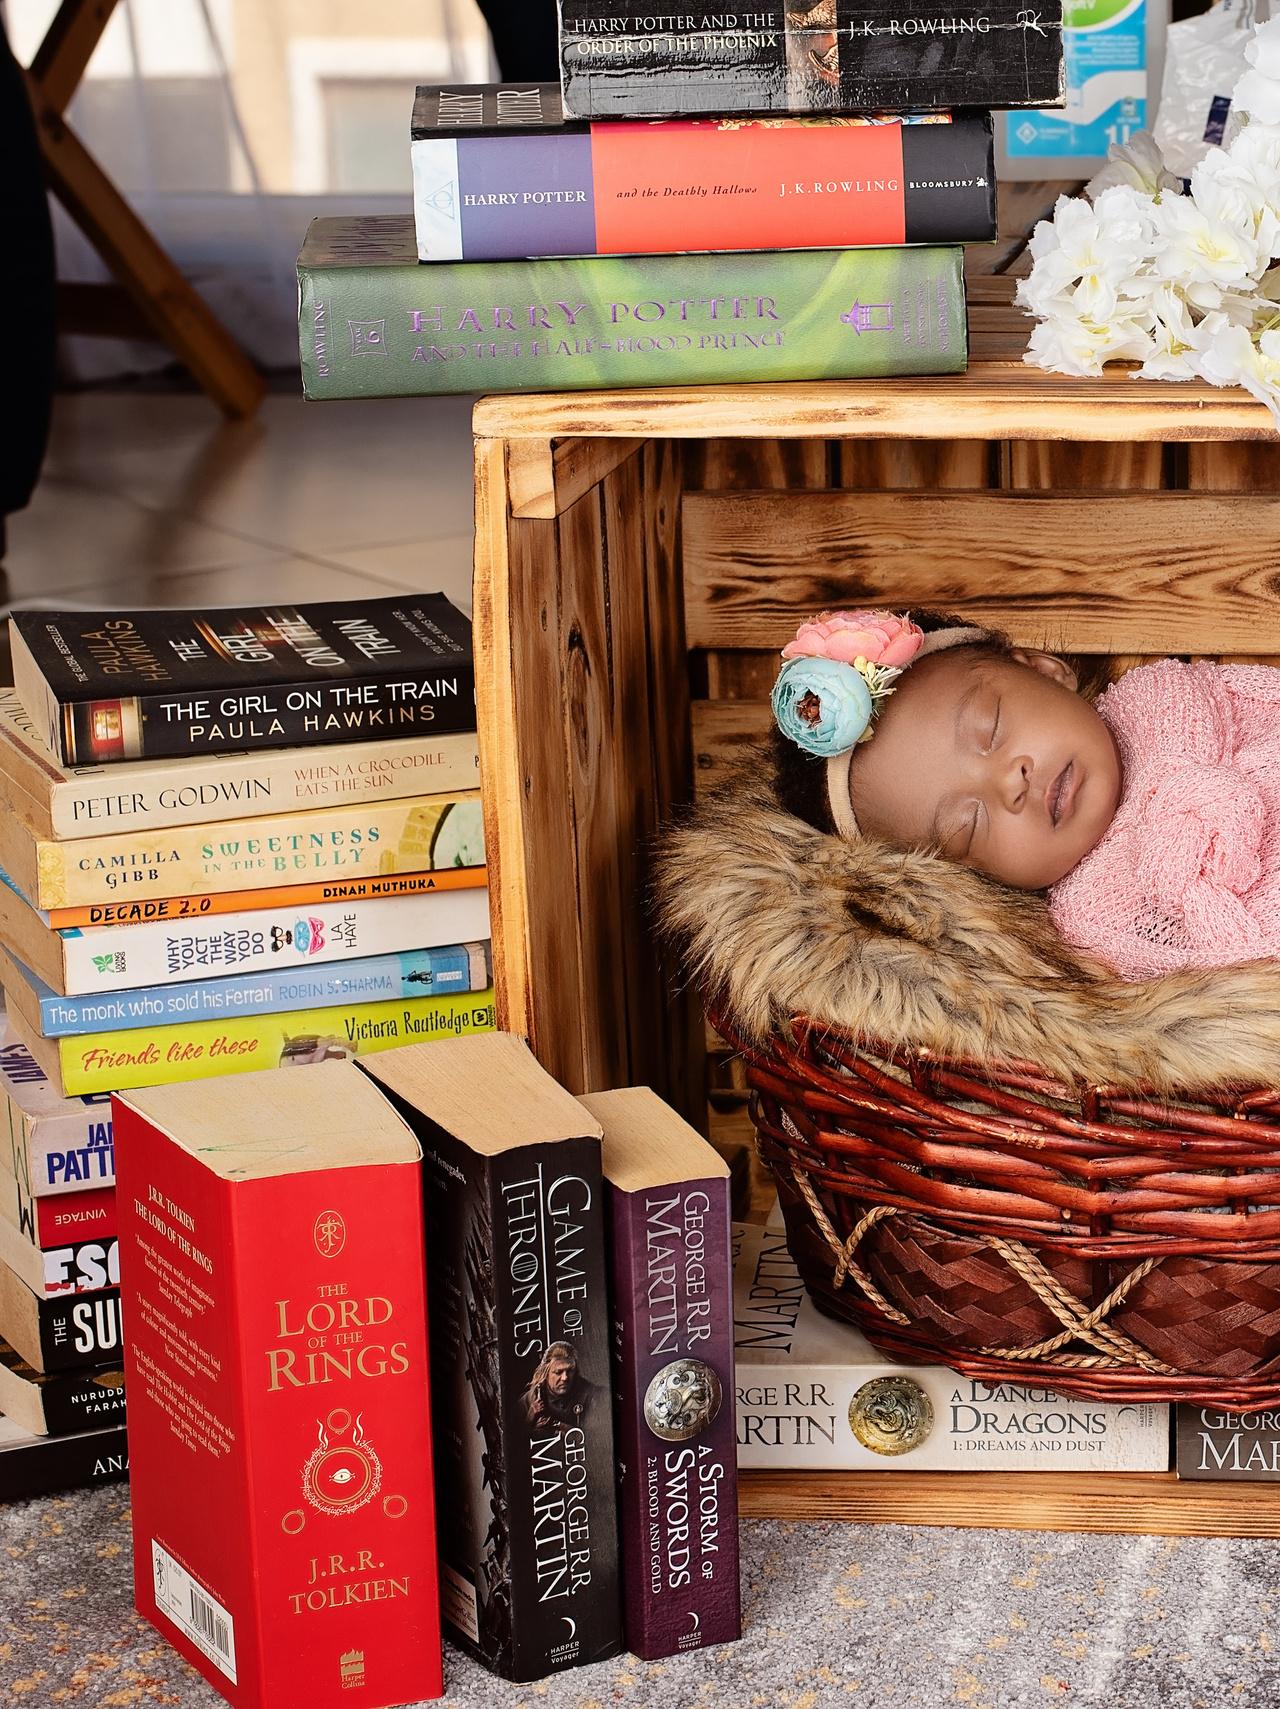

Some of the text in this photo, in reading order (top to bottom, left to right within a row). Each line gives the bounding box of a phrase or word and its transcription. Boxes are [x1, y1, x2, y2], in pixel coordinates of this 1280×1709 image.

[575, 12, 776, 33] HARRY POTTER AND THE
[849, 16, 991, 41] J.K. ROWLING
[577, 33, 778, 56] ORDER OF THE PHOENIX
[437, 91, 484, 126] HARRY
[464, 190, 588, 207] HARRY POTTER
[615, 183, 758, 199] and the Deathly Hallows
[908, 179, 974, 190] BLOOMSBURY
[406, 295, 780, 333] HARRY POTTER
[313, 299, 329, 378] ROWLING
[411, 330, 787, 363] AND THE HALF-BLOOD PRINCE
[81, 630, 133, 675] PAULA
[104, 619, 173, 682] HAWKINS
[168, 638, 208, 662] THE
[218, 627, 275, 663] GIRL
[332, 618, 402, 660] TRAIN
[294, 645, 347, 667] ON
[160, 677, 458, 722] THE GIRL ON THE TRAIN
[189, 704, 437, 743] PAULA HAWKINS
[294, 751, 446, 782] WHEN A CROCODILE
[72, 777, 272, 821] PETER GODWIN
[295, 773, 394, 798] EATS THE SUN
[201, 826, 381, 860] SWEETNESS
[78, 850, 182, 872] CAMILLA
[204, 847, 366, 874] IN THE BELLY
[105, 868, 160, 890] GIBB
[323, 878, 436, 899] DINAH MUTHUKA
[90, 900, 170, 924] DECADE
[179, 897, 212, 915] 2.0
[237, 929, 251, 962] YOU
[252, 932, 265, 955] DO
[330, 923, 344, 942] LA
[344, 913, 357, 948] HAYE
[166, 937, 181, 975] WHY
[181, 936, 194, 970] YOU
[195, 936, 209, 966] ACT
[210, 934, 223, 964] THE
[223, 930, 238, 966] WAY
[49, 984, 274, 1025] The monk who sold his Ferrari
[279, 975, 394, 1001] ROBIN SHARMA
[344, 1008, 470, 1042] Victoria Routledge
[81, 1036, 259, 1073] Friends like these
[55, 1208, 107, 1226] VINTAGE
[166, 1197, 196, 1234] TOLKIEN
[134, 1198, 214, 1276] THE LORD OF THE RINGS
[684, 1191, 710, 1297] GEORGE
[500, 1162, 544, 1358] THRONES
[547, 1174, 593, 1337] GAME OF
[317, 1283, 348, 1298] THE
[645, 1192, 682, 1357] MARTIN
[53, 1317, 68, 1346] THE
[274, 1296, 394, 1338] LORD
[307, 1331, 364, 1349] OF THE
[264, 1342, 410, 1392] RINGS
[784, 1383, 835, 1407] R.R.
[950, 1388, 964, 1403] A
[950, 1404, 1108, 1436] DRAGONS
[966, 1440, 1107, 1452] DREAMS AND DUST
[564, 1426, 590, 1546] GEORGE
[530, 1430, 571, 1603] MARTIN
[664, 1448, 696, 1588] SWORDS
[698, 1444, 724, 1580] A STORM OF
[647, 1470, 662, 1594] BLOOD AND GOLD
[308, 1549, 386, 1585] J.R.R.
[288, 1576, 410, 1616] TOLKIEN
[550, 1640, 580, 1655] HARPER
[678, 1632, 702, 1643] HARPER
[678, 1639, 702, 1650] Voyager
[551, 1651, 580, 1665] Voyager
[341, 1674, 366, 1686] Harper
[341, 1681, 366, 1690] Collins
